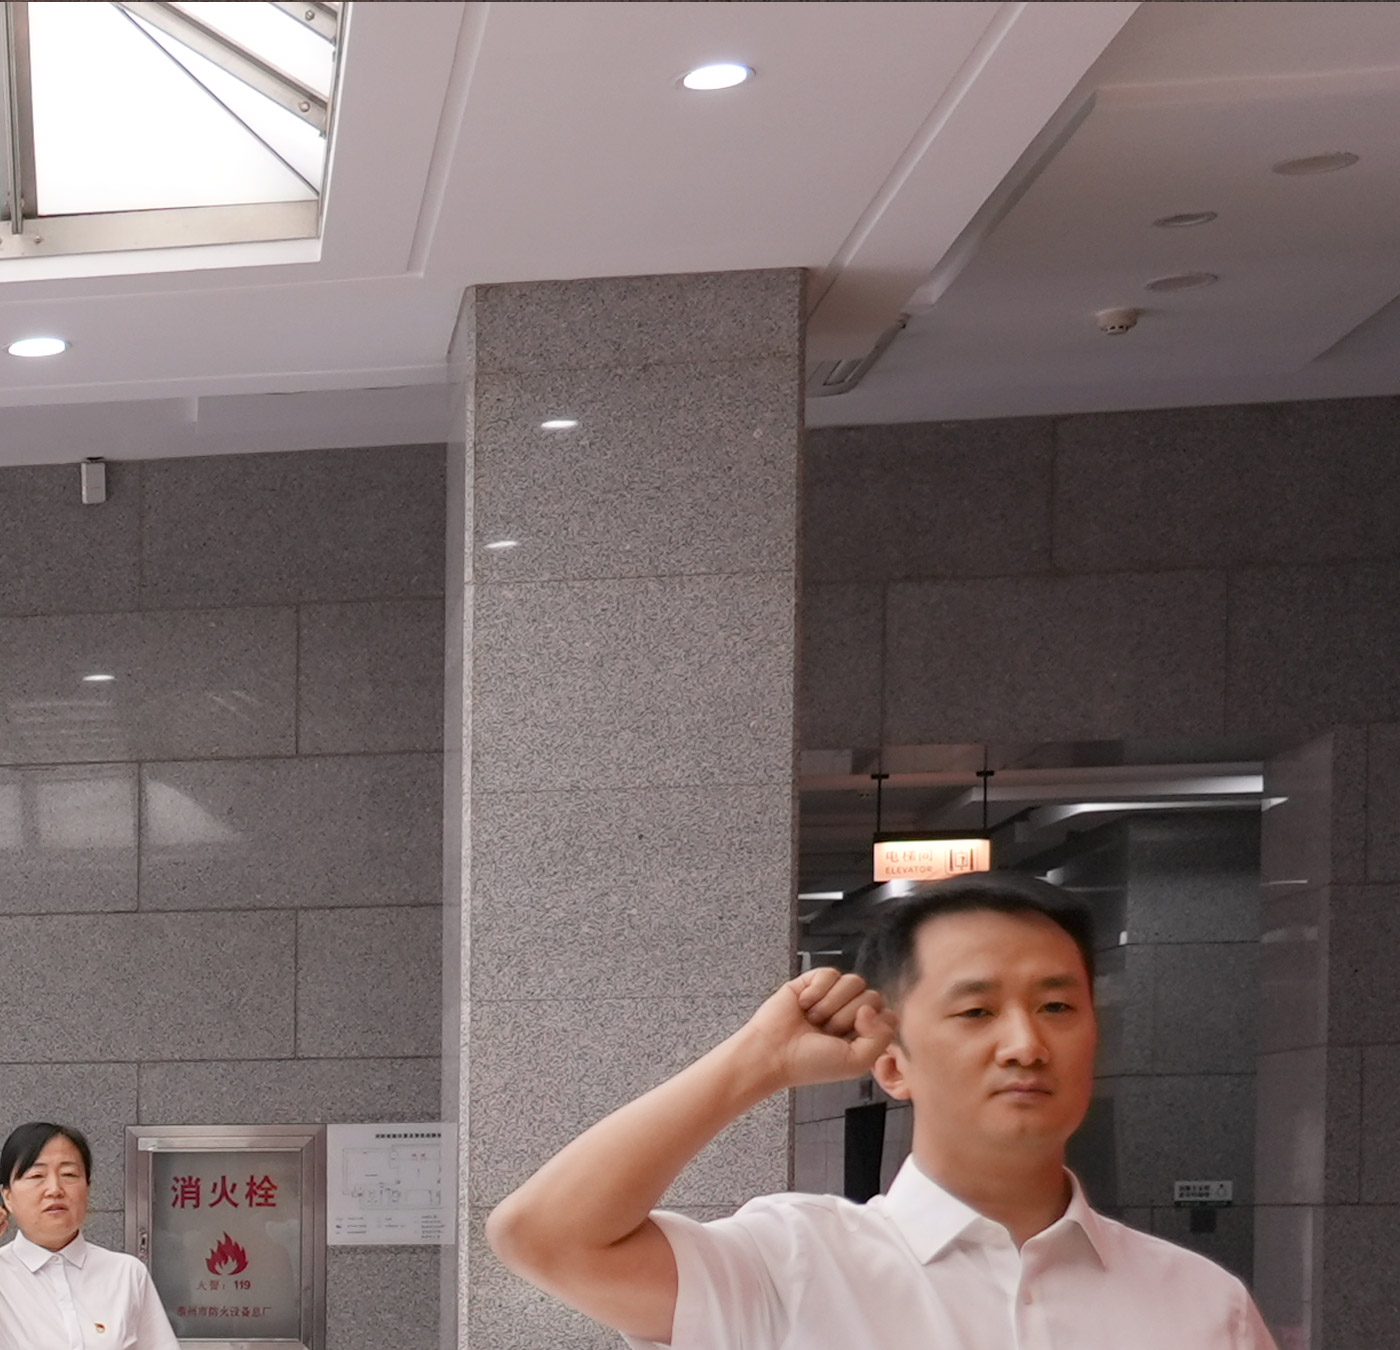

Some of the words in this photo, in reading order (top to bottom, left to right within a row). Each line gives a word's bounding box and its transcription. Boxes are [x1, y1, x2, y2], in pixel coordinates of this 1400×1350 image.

[886, 849, 933, 863] 电梯间
[885, 865, 933, 875] ELEVATOR
[171, 1174, 279, 1209] 消火栓
[234, 1279, 252, 1291] 119
